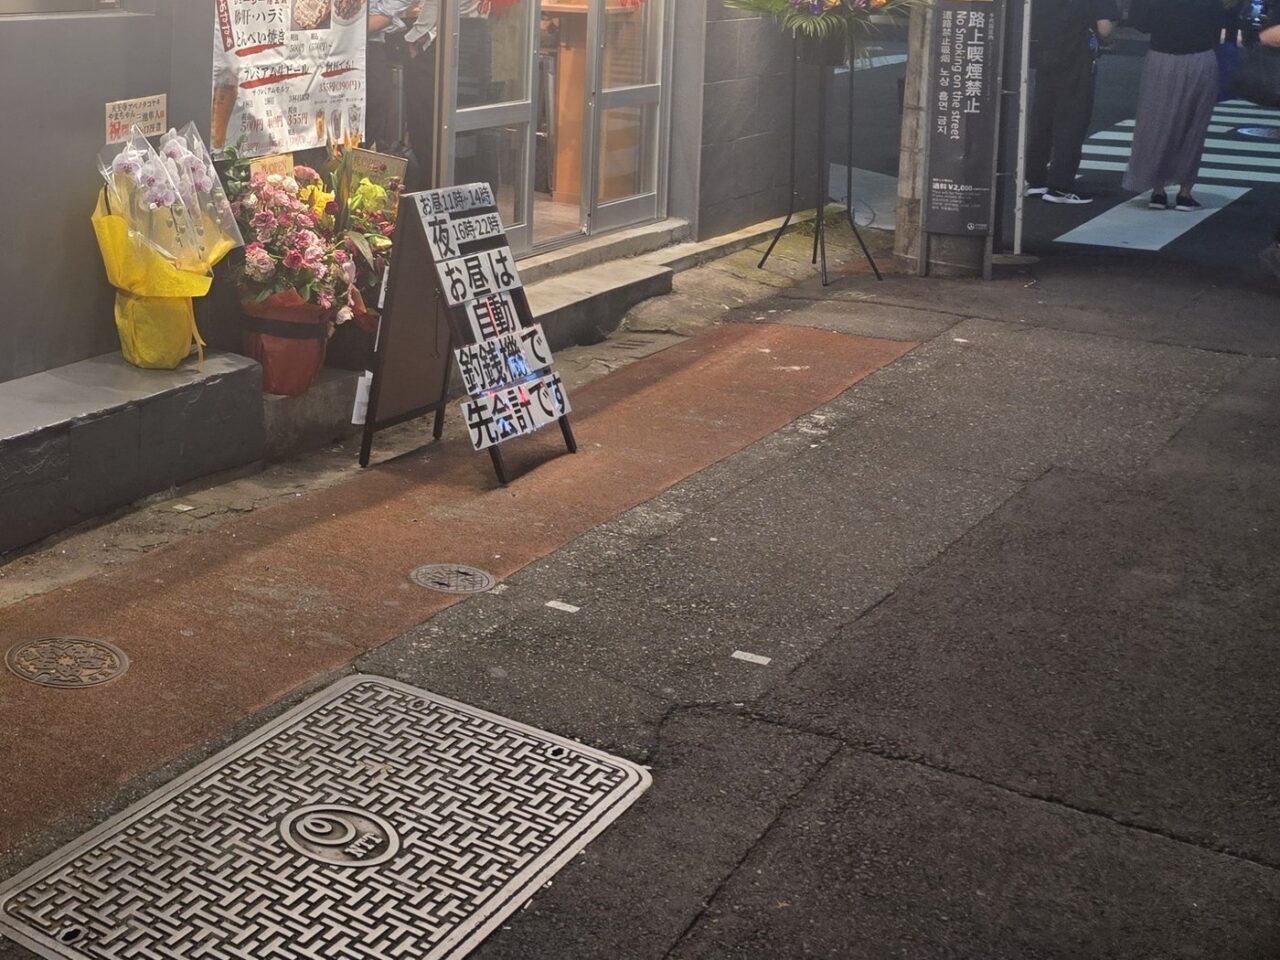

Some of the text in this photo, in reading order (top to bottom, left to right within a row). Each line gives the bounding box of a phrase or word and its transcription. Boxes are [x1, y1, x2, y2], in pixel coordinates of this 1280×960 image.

[950, 10, 967, 140] No Smoking on the street
[964, 11, 985, 113] 路上喫煙禁止
[287, 113, 308, 125] 355円
[428, 216, 455, 259] 夜
[445, 250, 515, 301] お昼は
[473, 293, 516, 340] 自動
[459, 329, 547, 391] 釣銭機で
[467, 374, 569, 448] 先会計です
[344, 832, 383, 858] NTT
